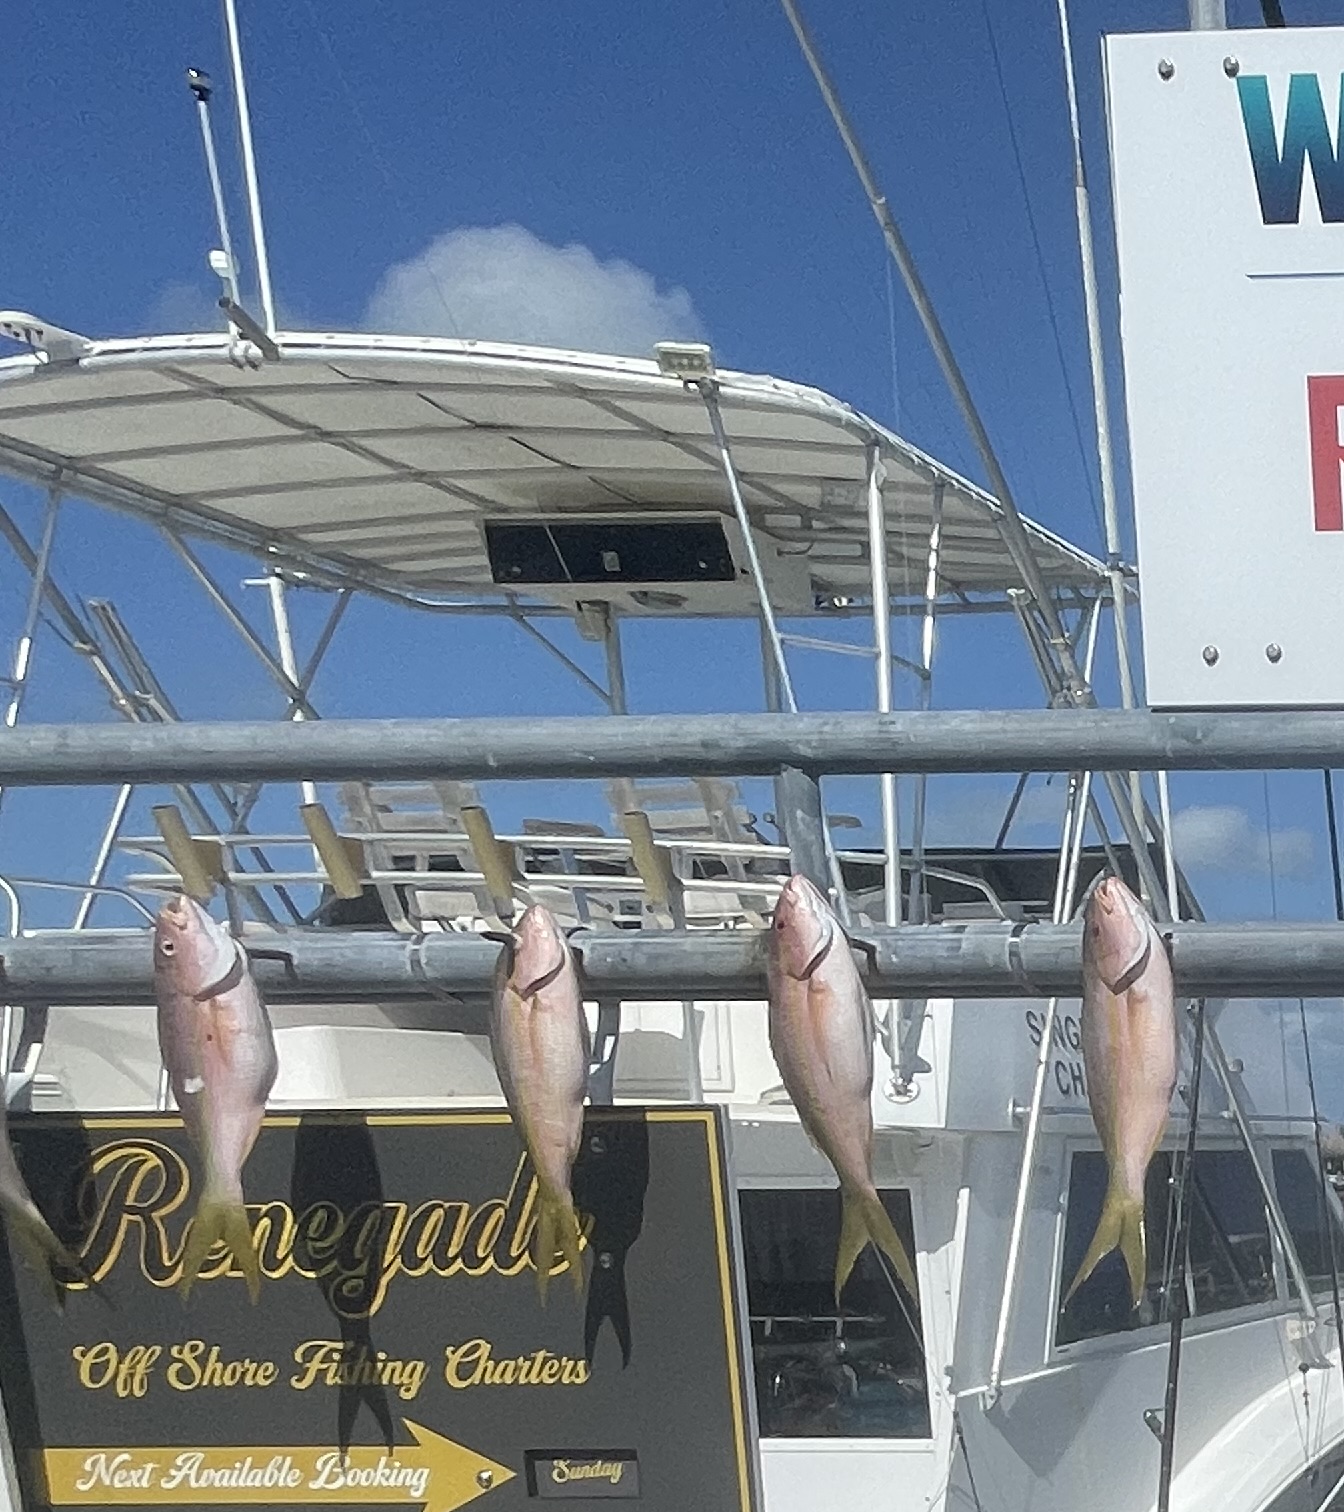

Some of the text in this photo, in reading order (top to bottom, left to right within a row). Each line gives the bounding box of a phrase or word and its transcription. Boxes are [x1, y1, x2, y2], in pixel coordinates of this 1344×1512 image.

[73, 1337, 591, 1400] Off Shore Fishing Charters
[75, 1452, 432, 1497] Next Available Booking
[552, 1460, 623, 1484] Sunday
